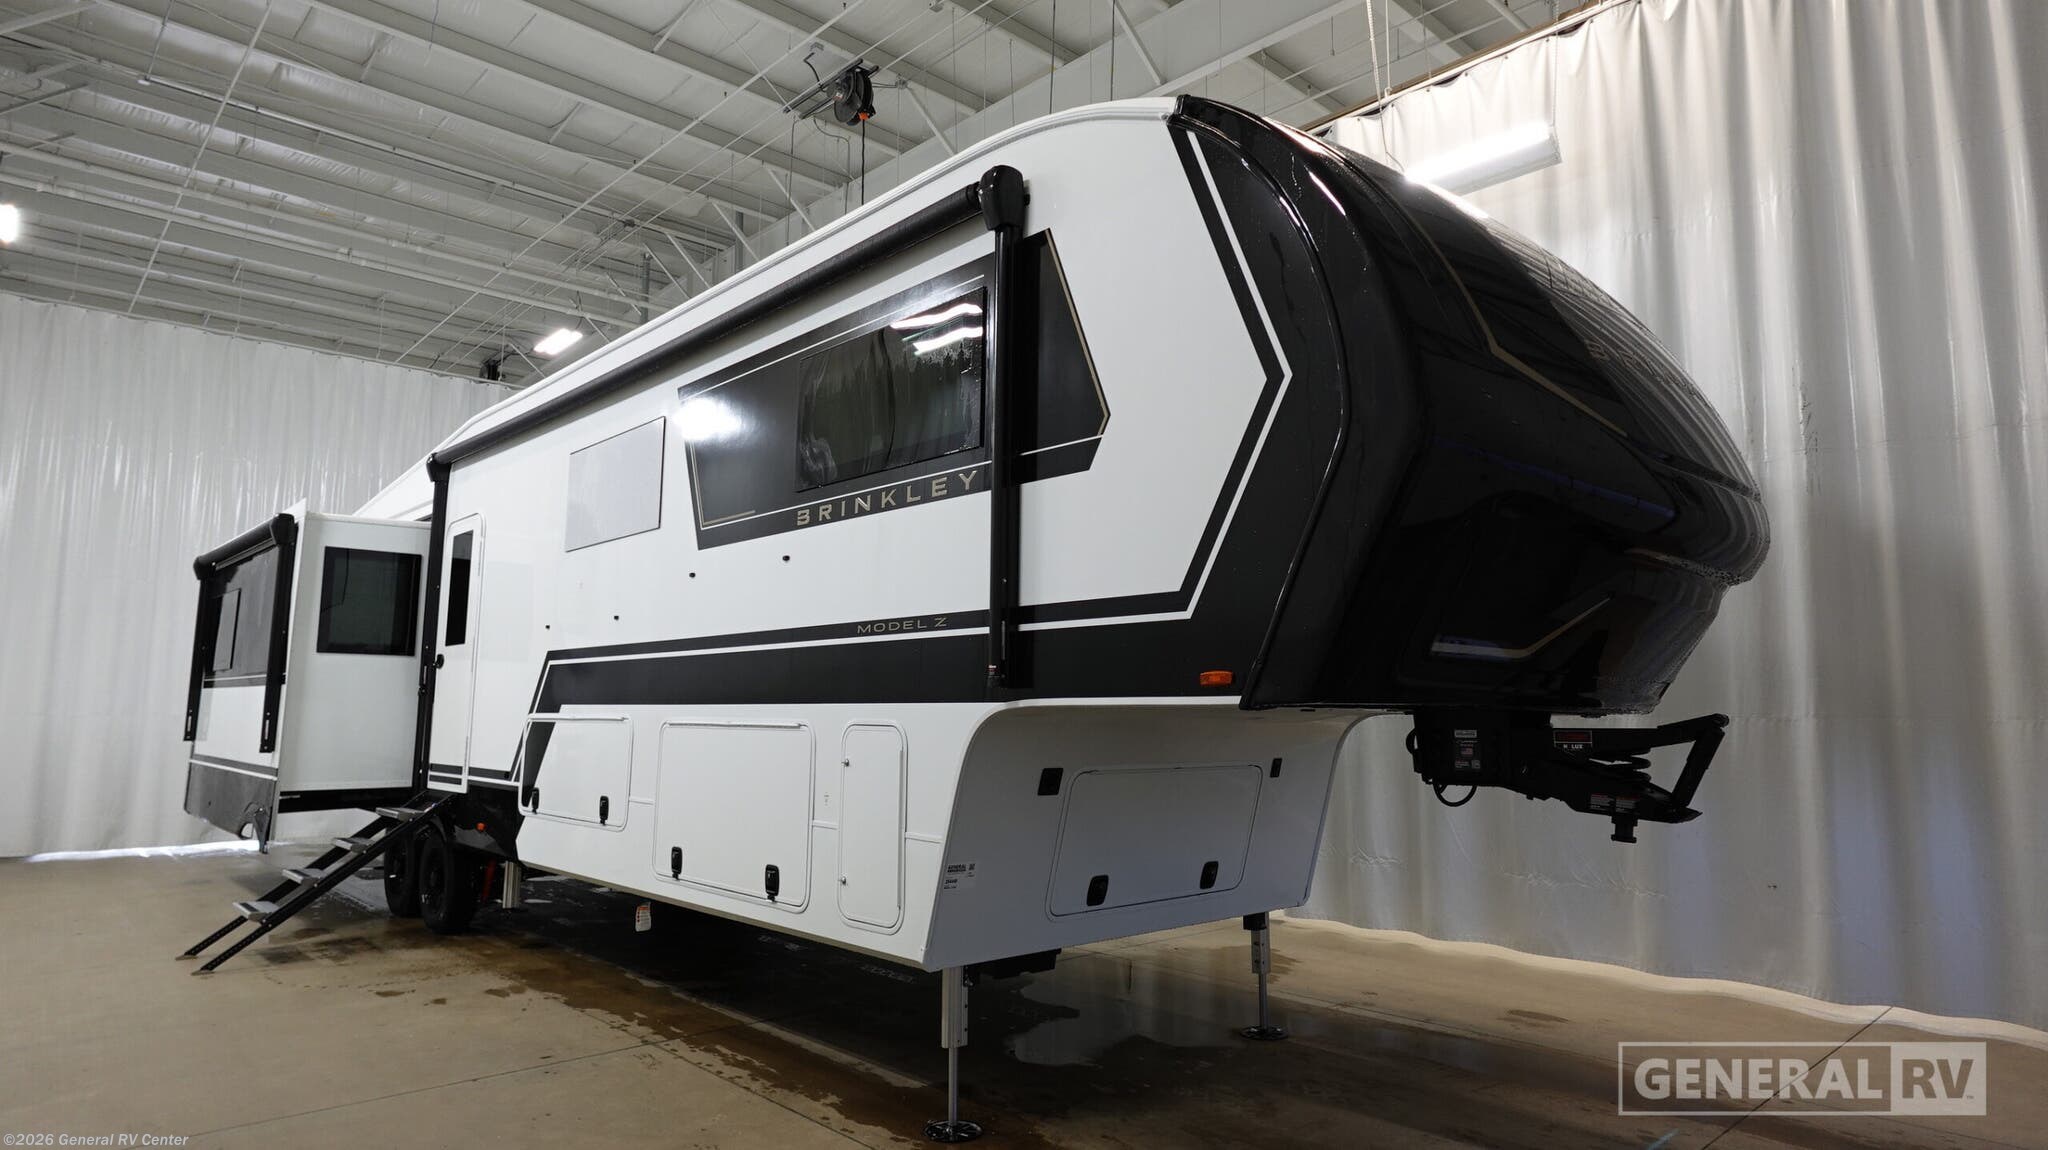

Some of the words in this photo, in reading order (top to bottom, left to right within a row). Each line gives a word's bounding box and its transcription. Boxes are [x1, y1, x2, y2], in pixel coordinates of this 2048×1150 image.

[796, 470, 978, 527] BRINKLEY
[857, 619, 928, 634] MODEL
[934, 617, 948, 628] Z
